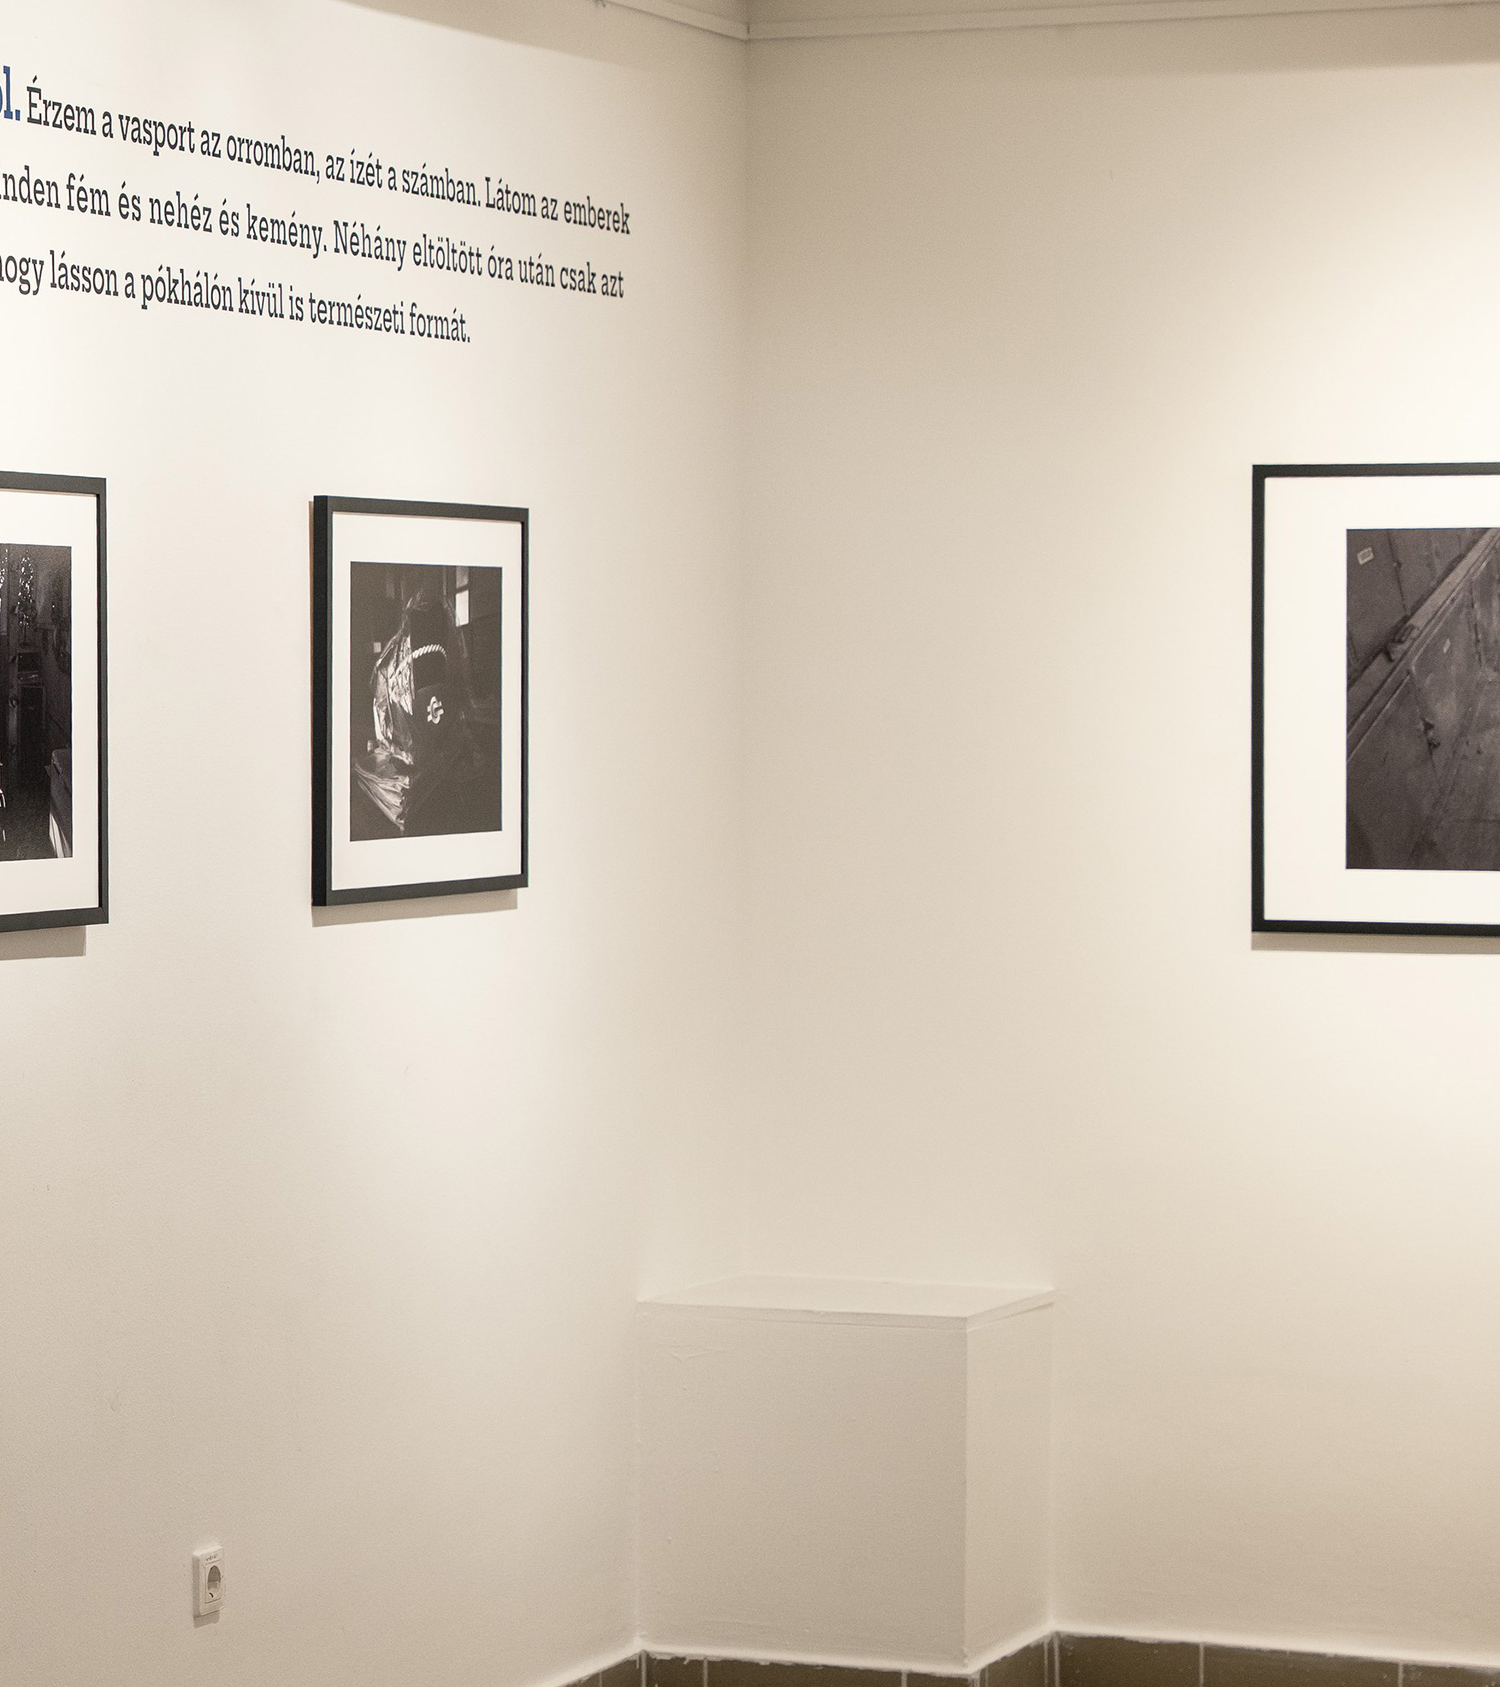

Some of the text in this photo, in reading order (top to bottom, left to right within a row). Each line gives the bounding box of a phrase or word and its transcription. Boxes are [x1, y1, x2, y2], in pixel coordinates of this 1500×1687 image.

[26, 74, 97, 136] Érzem
[101, 110, 114, 139] a
[117, 113, 196, 157] vasport
[200, 129, 222, 159] az
[226, 134, 320, 185] orromban,
[325, 154, 345, 182] az
[349, 148, 383, 189] ízét
[387, 166, 398, 192] a
[401, 162, 481, 208] számban.
[484, 176, 538, 218] Látom
[540, 196, 559, 222] az
[563, 195, 631, 235] emberek
[49, 249, 119, 297] lásson
[124, 271, 136, 299] a
[140, 264, 235, 313] pókhálón
[237, 276, 285, 319] kívül
[288, 284, 304, 322] is
[308, 292, 406, 335] természeti
[409, 301, 471, 343] formát.
[65, 172, 112, 217] fém
[118, 180, 142, 222] és
[148, 190, 213, 234] nehéz
[218, 197, 240, 238] és
[246, 202, 328, 260] kemény.
[332, 219, 407, 272] Néhány
[412, 233, 483, 277] eltöltött
[487, 244, 514, 282] óra
[518, 252, 556, 288] után
[559, 261, 597, 295] csak
[601, 271, 624, 299] azt
